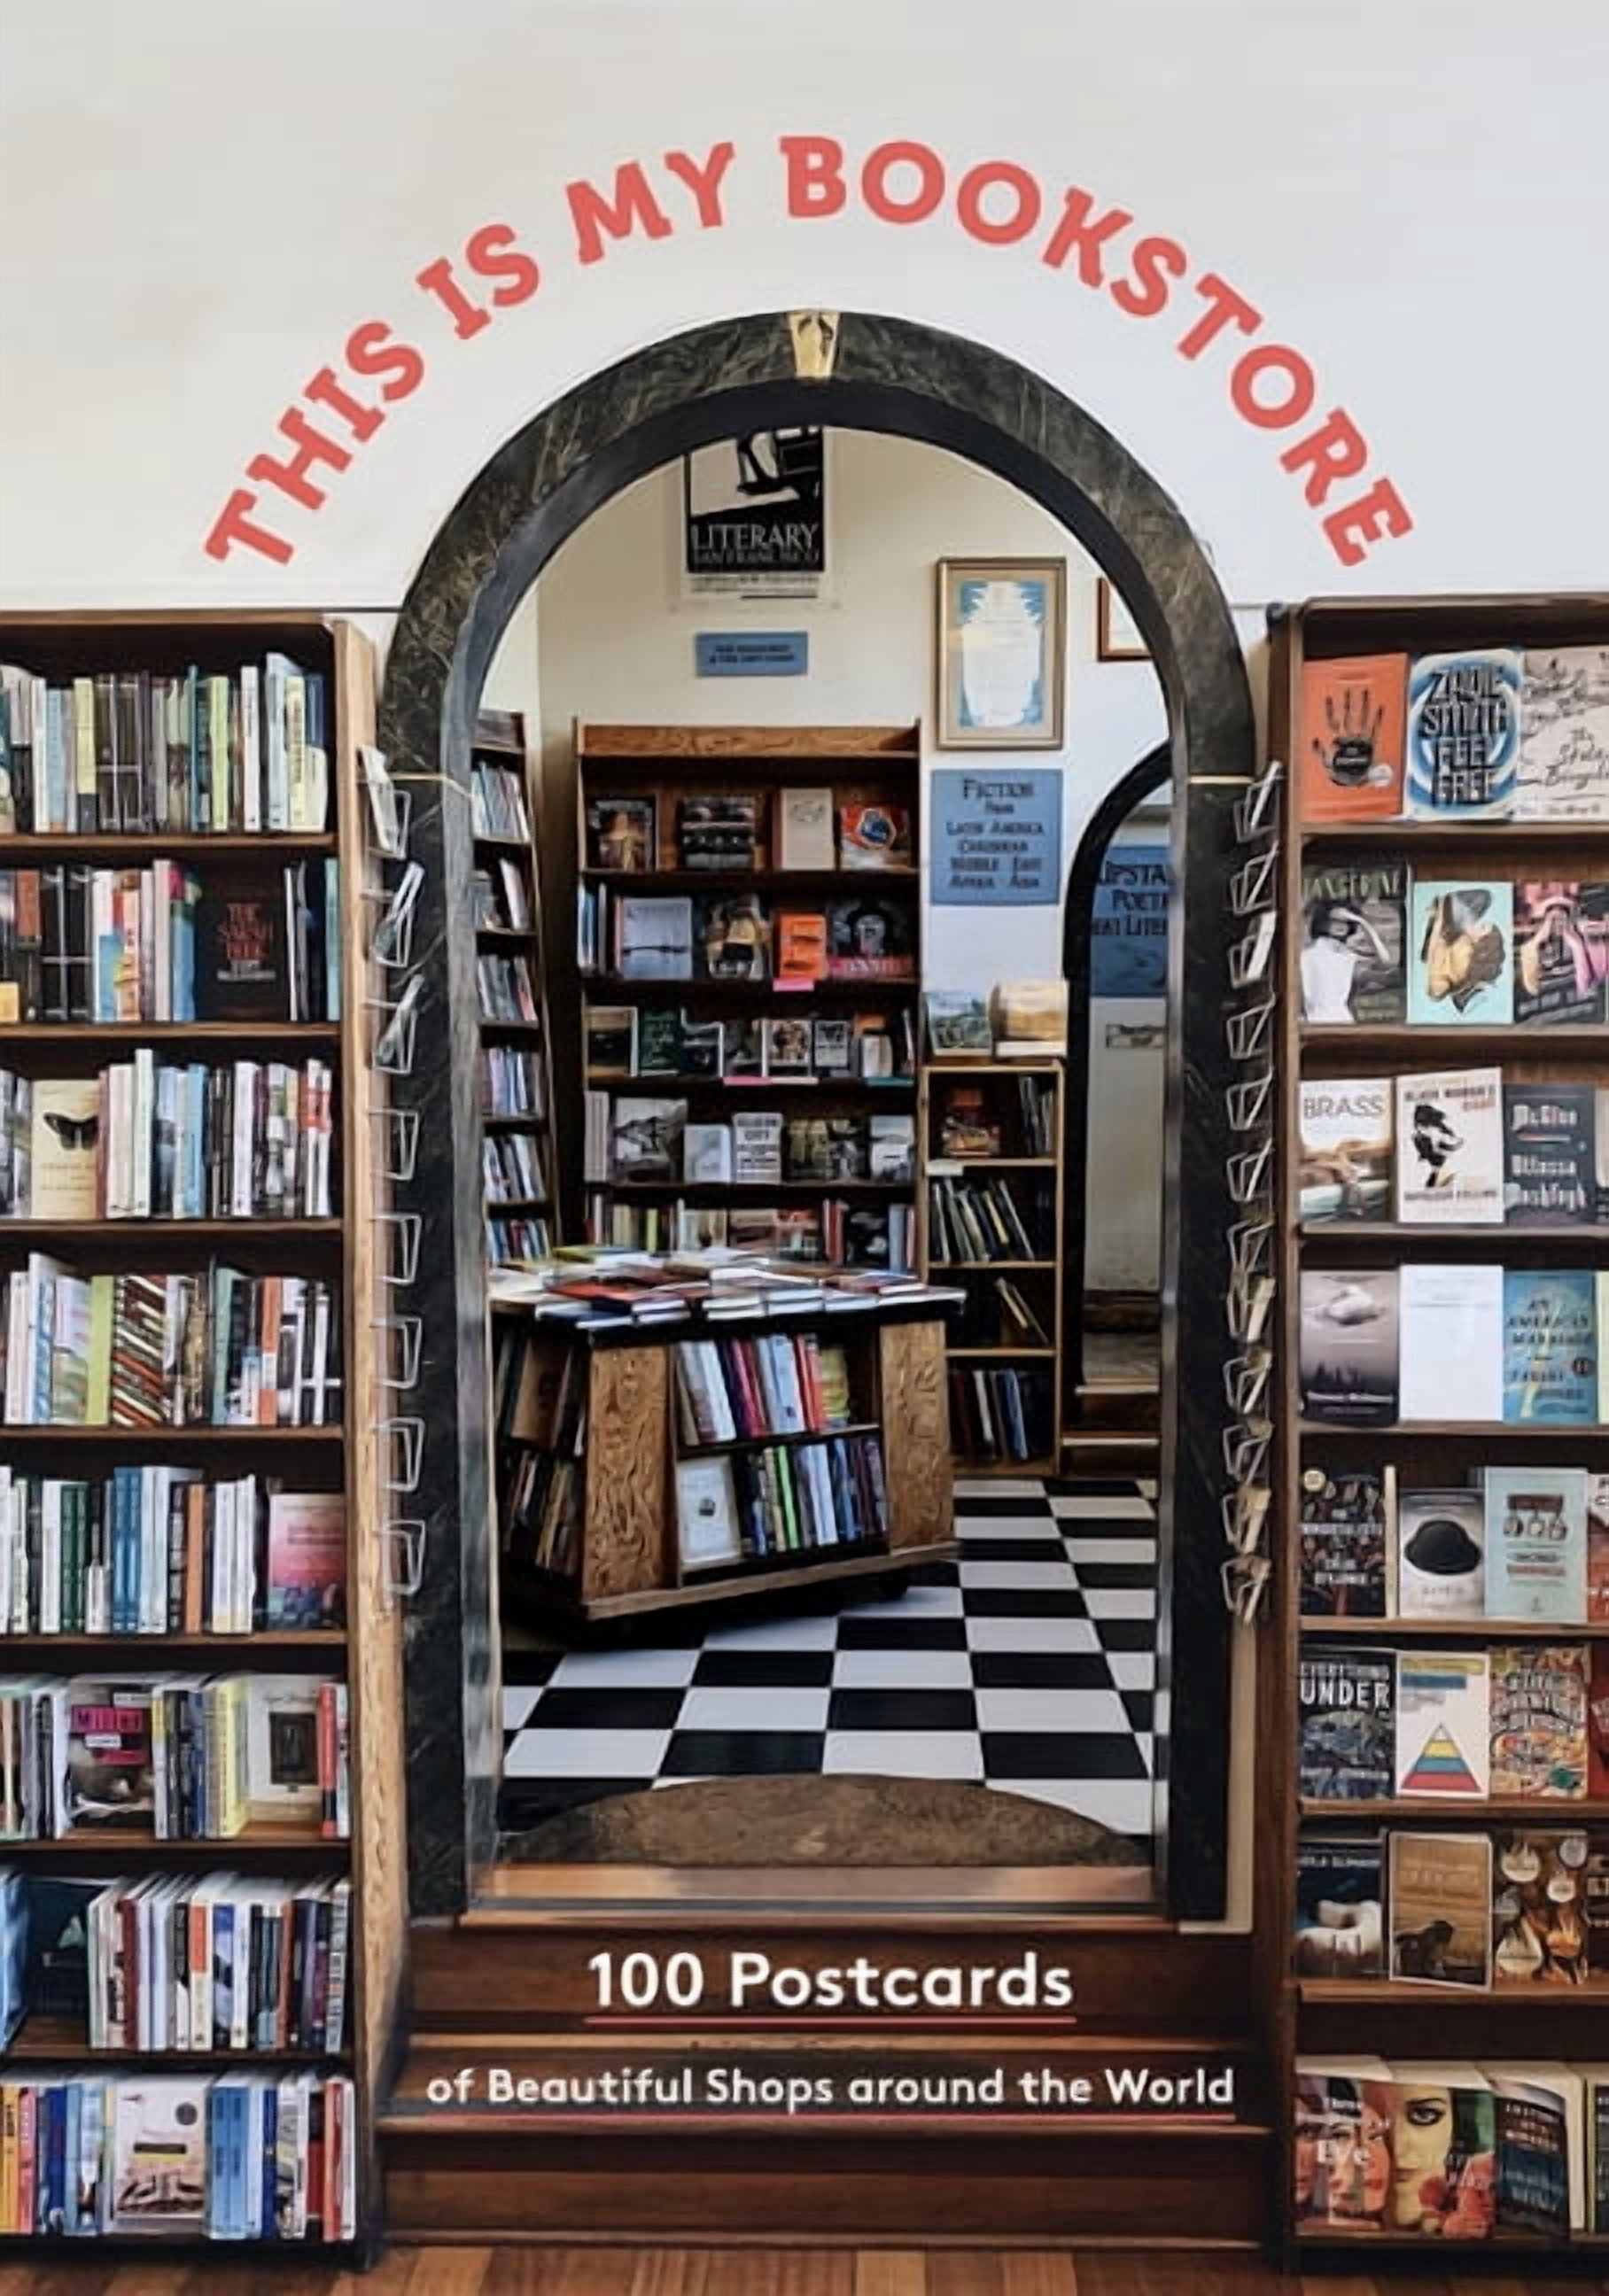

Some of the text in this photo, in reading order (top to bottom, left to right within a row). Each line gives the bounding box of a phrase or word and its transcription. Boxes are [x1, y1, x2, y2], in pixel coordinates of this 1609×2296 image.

[690, 524, 818, 550] LITERARY
[1304, 1095, 1385, 1119] BRASS
[1300, 1678, 1389, 1709] UNDER
